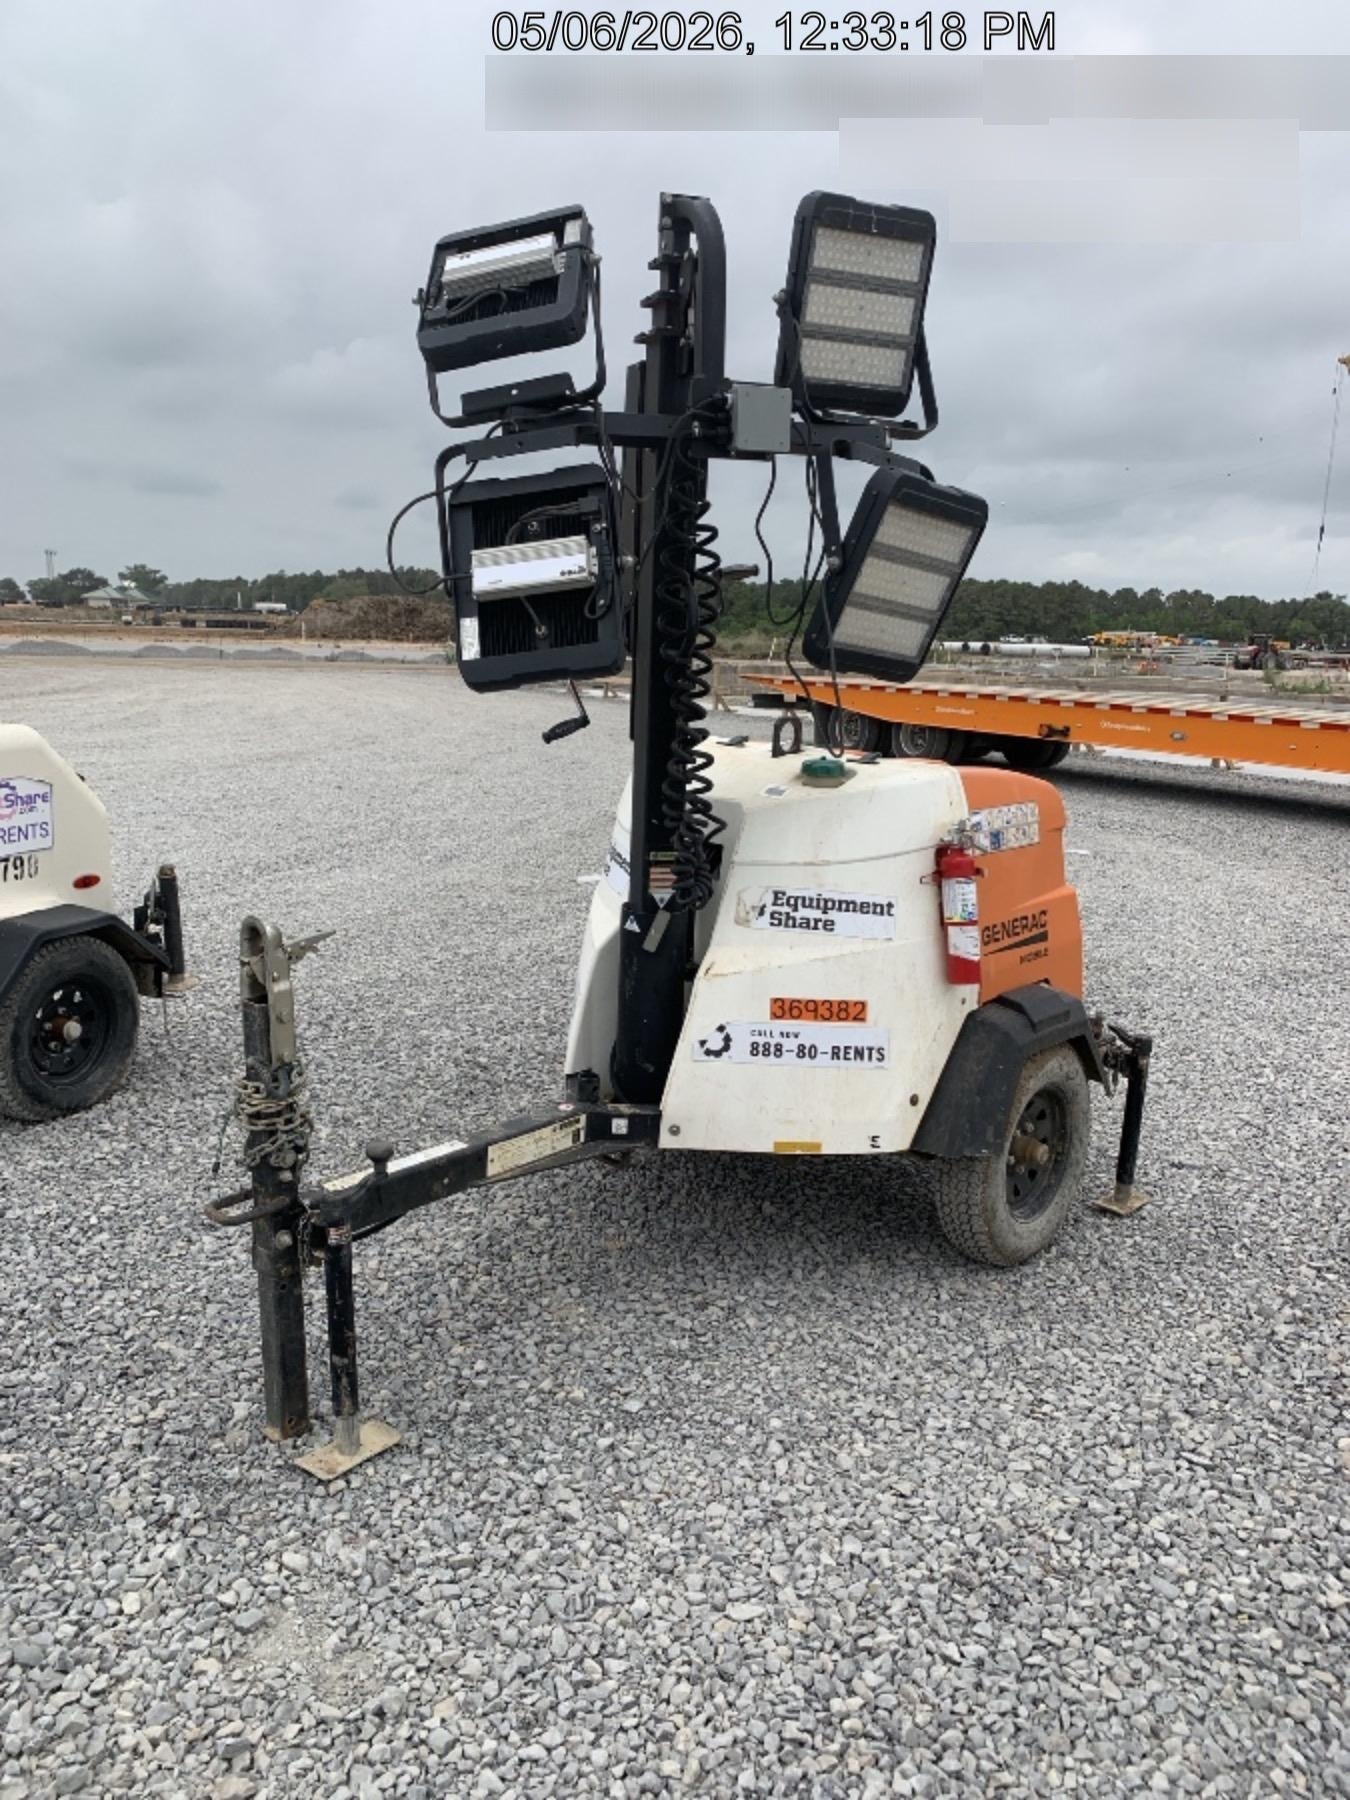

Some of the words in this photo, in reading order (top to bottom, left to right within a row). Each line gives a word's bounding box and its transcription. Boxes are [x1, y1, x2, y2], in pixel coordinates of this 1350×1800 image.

[4, 791, 49, 808] Share
[771, 890, 895, 917] Equipment
[769, 910, 836, 932] Share
[981, 909, 1048, 947] GENERAC
[772, 999, 867, 1021] 369382
[749, 1041, 886, 1063] 888-80-RENTS
